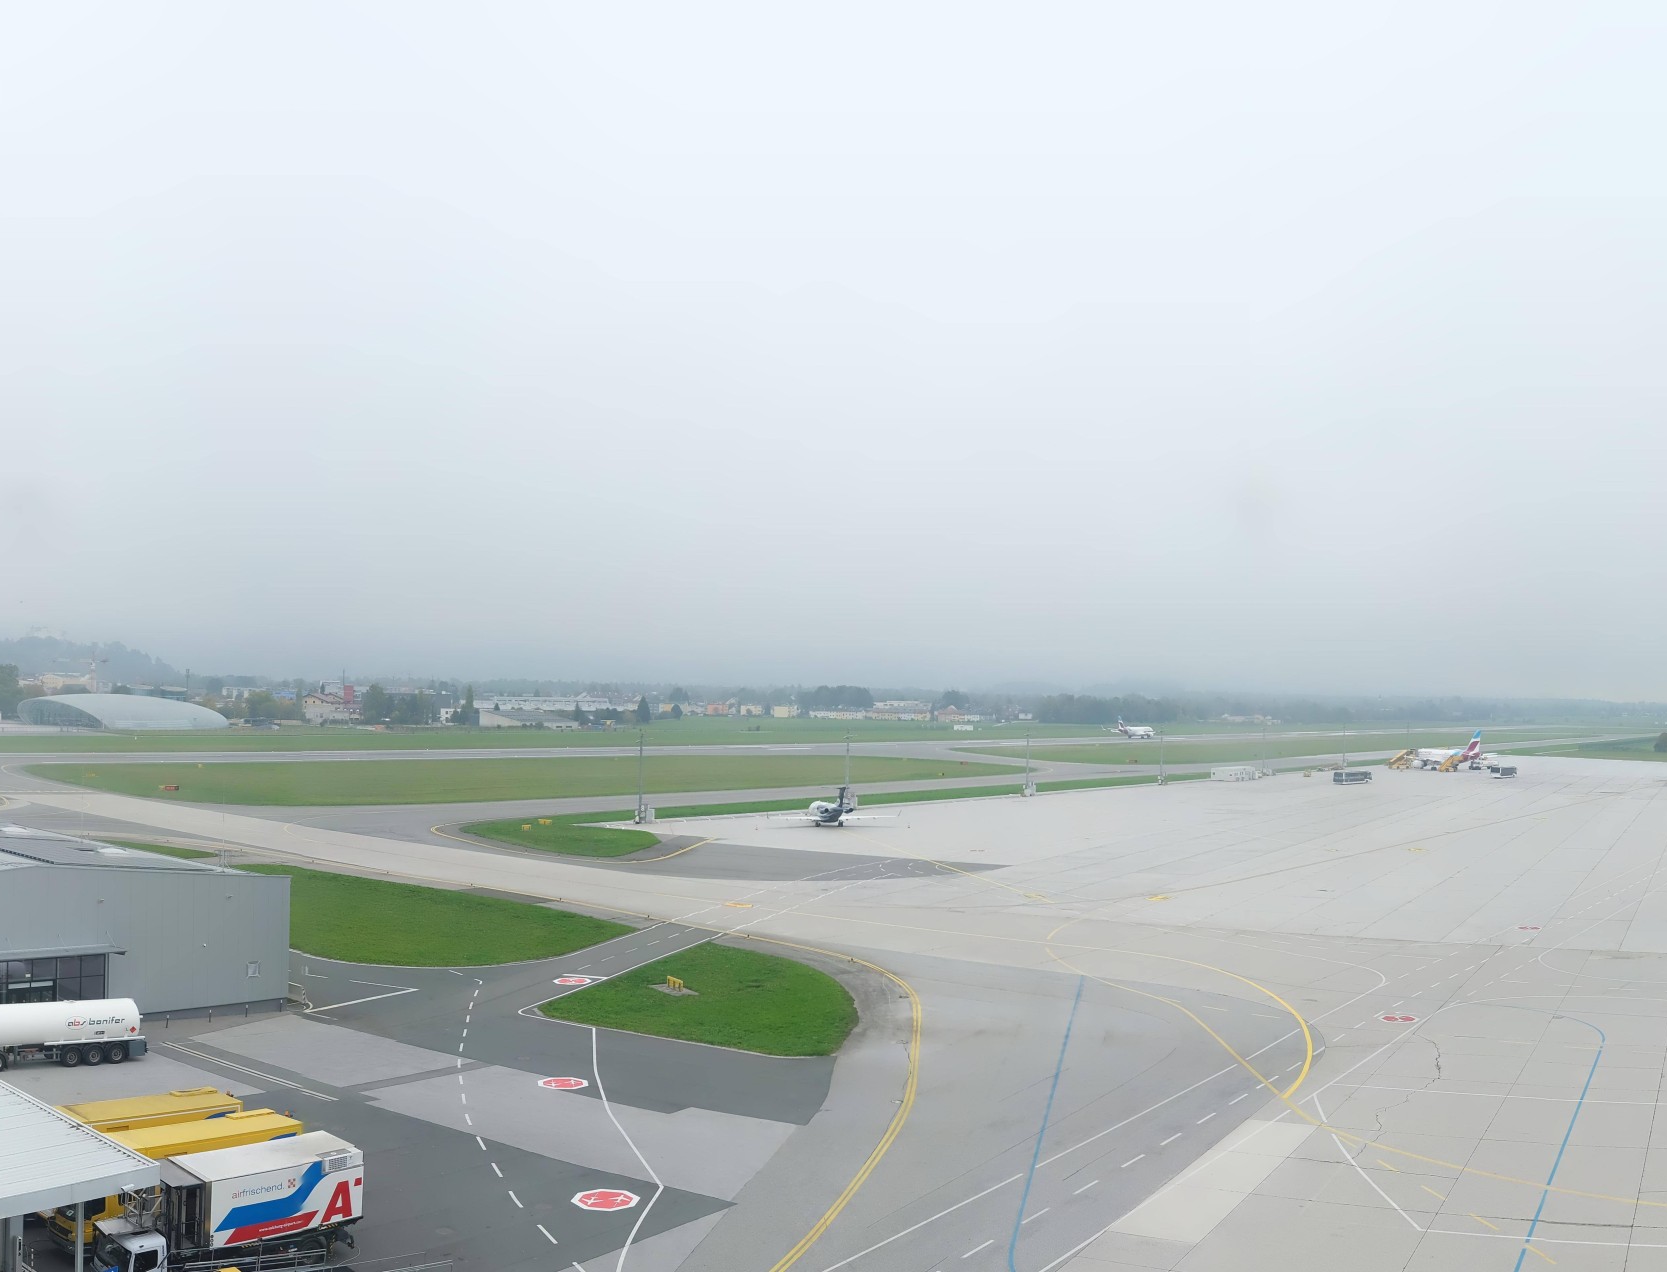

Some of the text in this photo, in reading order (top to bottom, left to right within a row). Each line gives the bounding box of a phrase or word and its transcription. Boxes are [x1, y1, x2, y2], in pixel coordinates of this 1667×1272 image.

[67, 1016, 126, 1027] abs bonifer
[231, 1182, 285, 1200] airfrischend.
